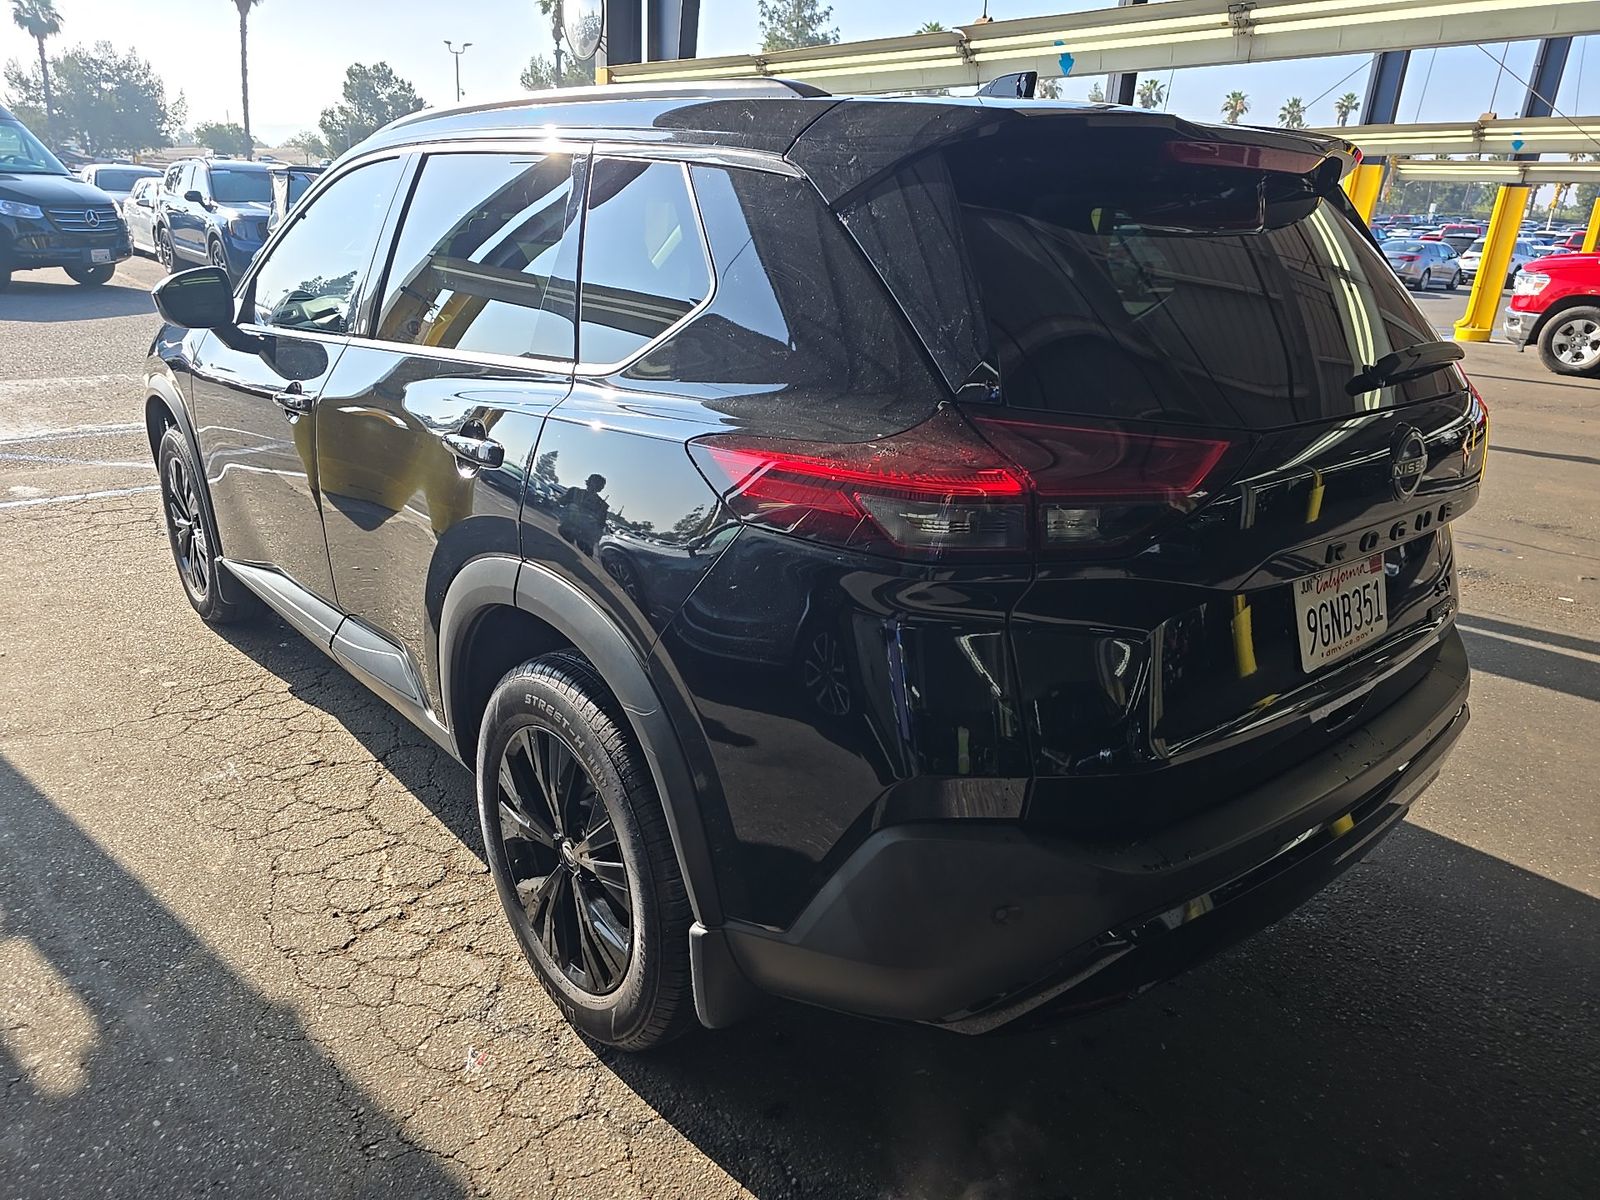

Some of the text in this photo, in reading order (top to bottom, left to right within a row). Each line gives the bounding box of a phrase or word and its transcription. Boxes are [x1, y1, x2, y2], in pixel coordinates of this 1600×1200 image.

[1325, 501, 1452, 563] ROGUE
[1315, 563, 1370, 595] California
[1306, 579, 1384, 656] 9GNB351
[1326, 631, 1370, 657] dmv.ca.gov
